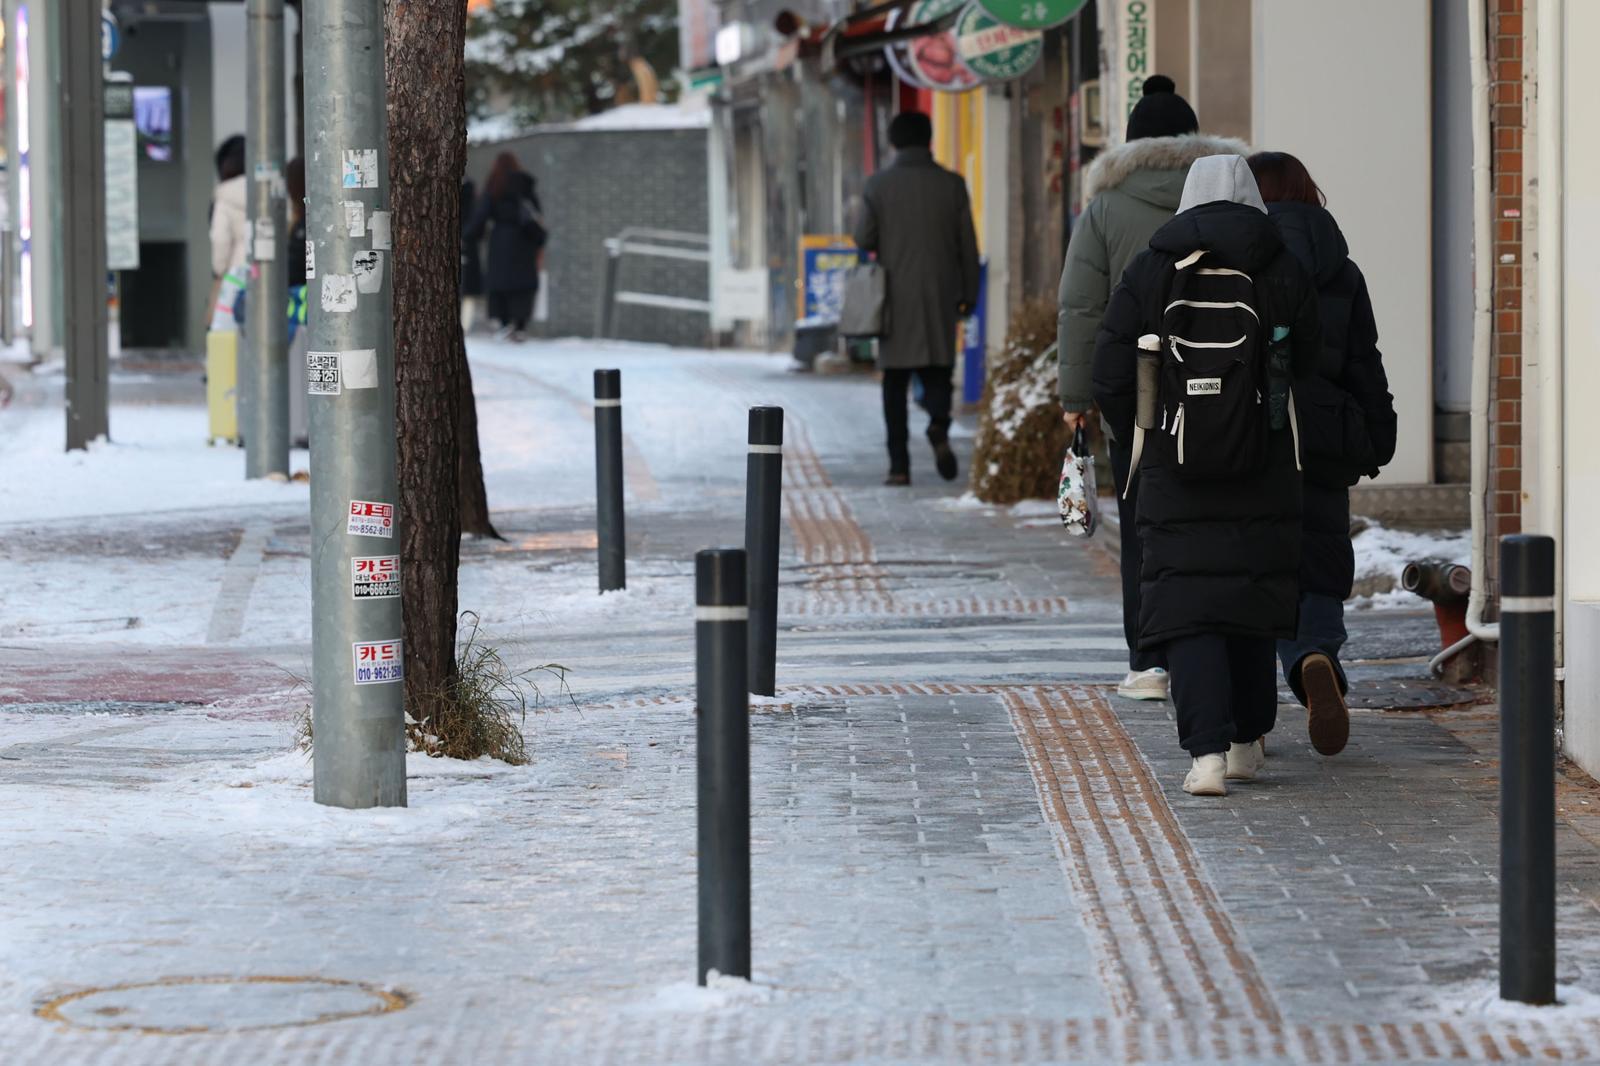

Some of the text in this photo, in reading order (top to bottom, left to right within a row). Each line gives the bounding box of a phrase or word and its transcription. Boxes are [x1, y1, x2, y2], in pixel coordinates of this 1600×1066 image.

[1127, 1, 1147, 73] 오징어
[352, 503, 383, 516] 카드
[356, 559, 393, 572] 카드
[360, 645, 394, 661] 카드
